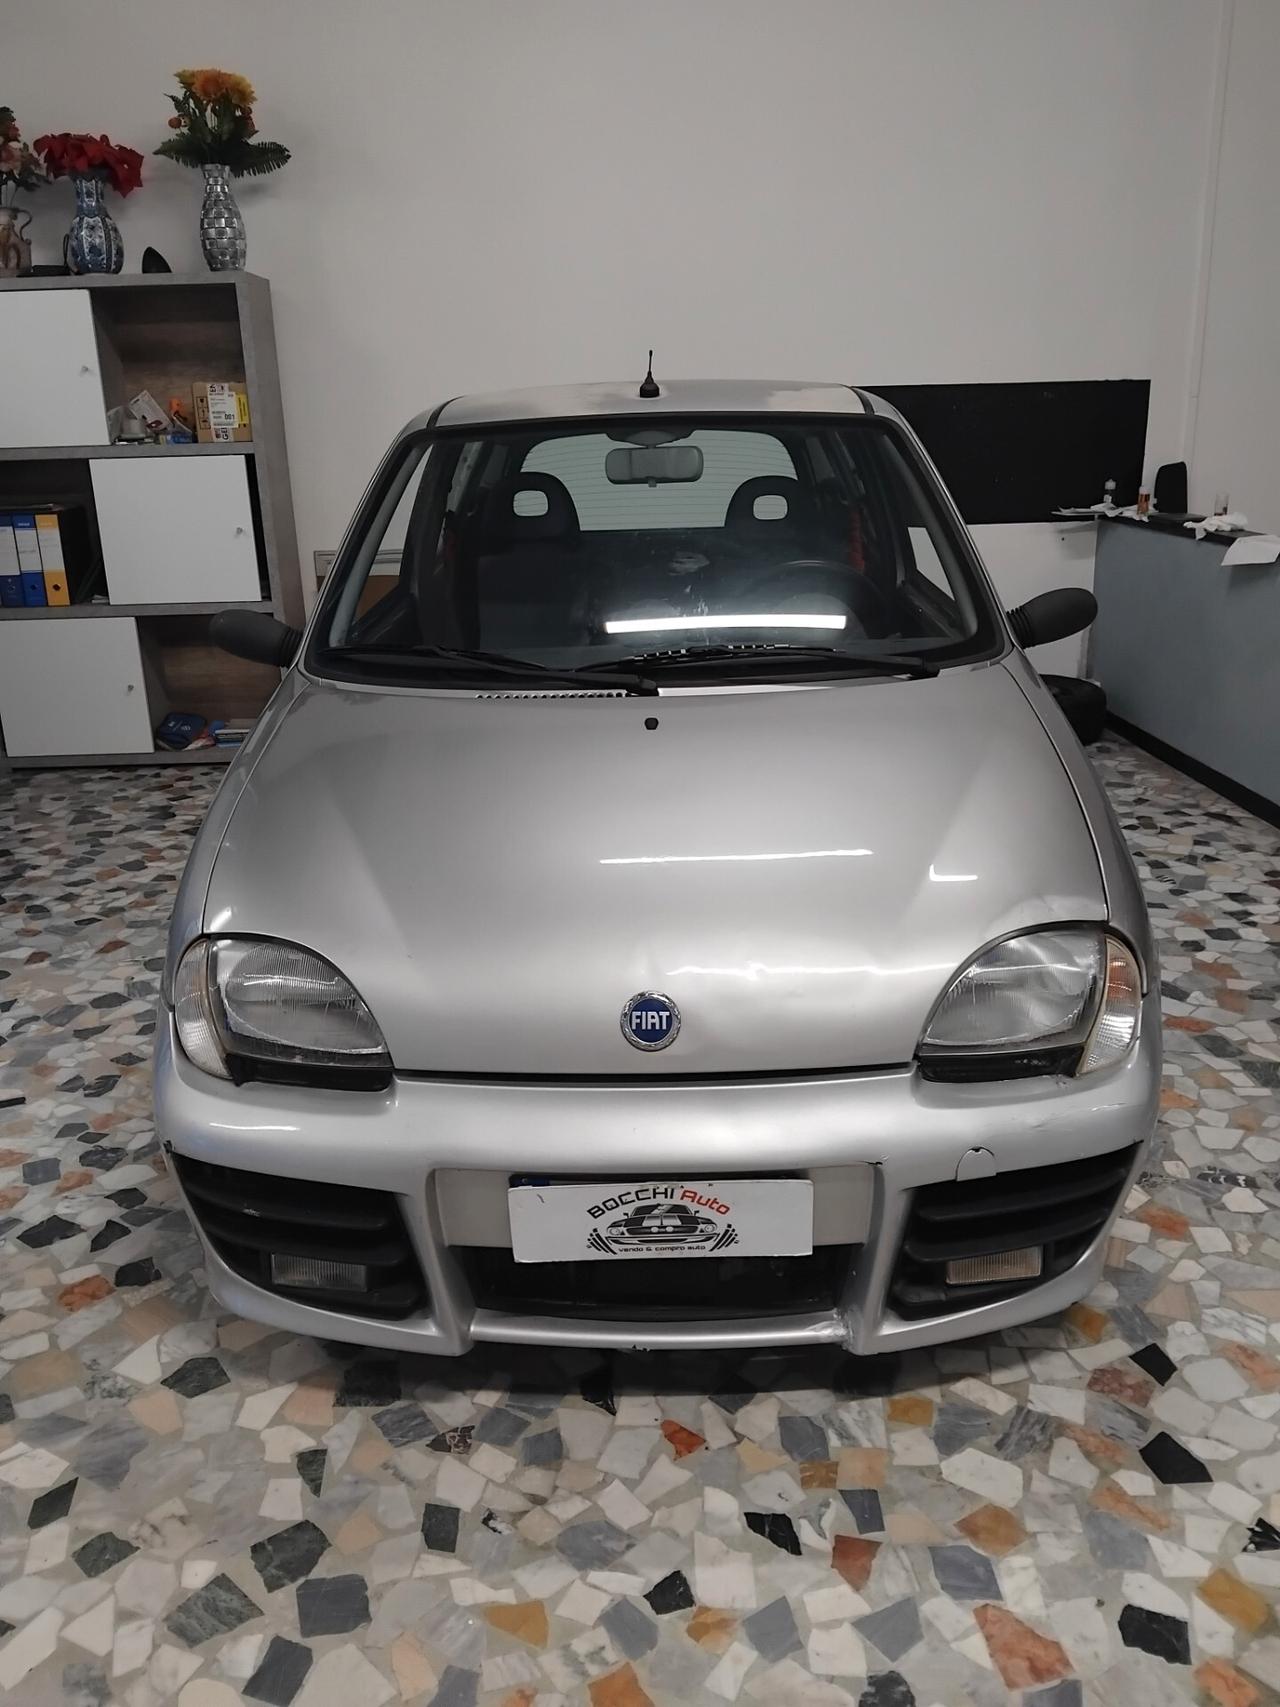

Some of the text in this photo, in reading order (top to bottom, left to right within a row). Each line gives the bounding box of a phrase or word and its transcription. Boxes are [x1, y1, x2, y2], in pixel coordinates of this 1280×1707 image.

[631, 1010, 670, 1030] FIAT
[587, 1188, 730, 1219] BOCCHI Auto
